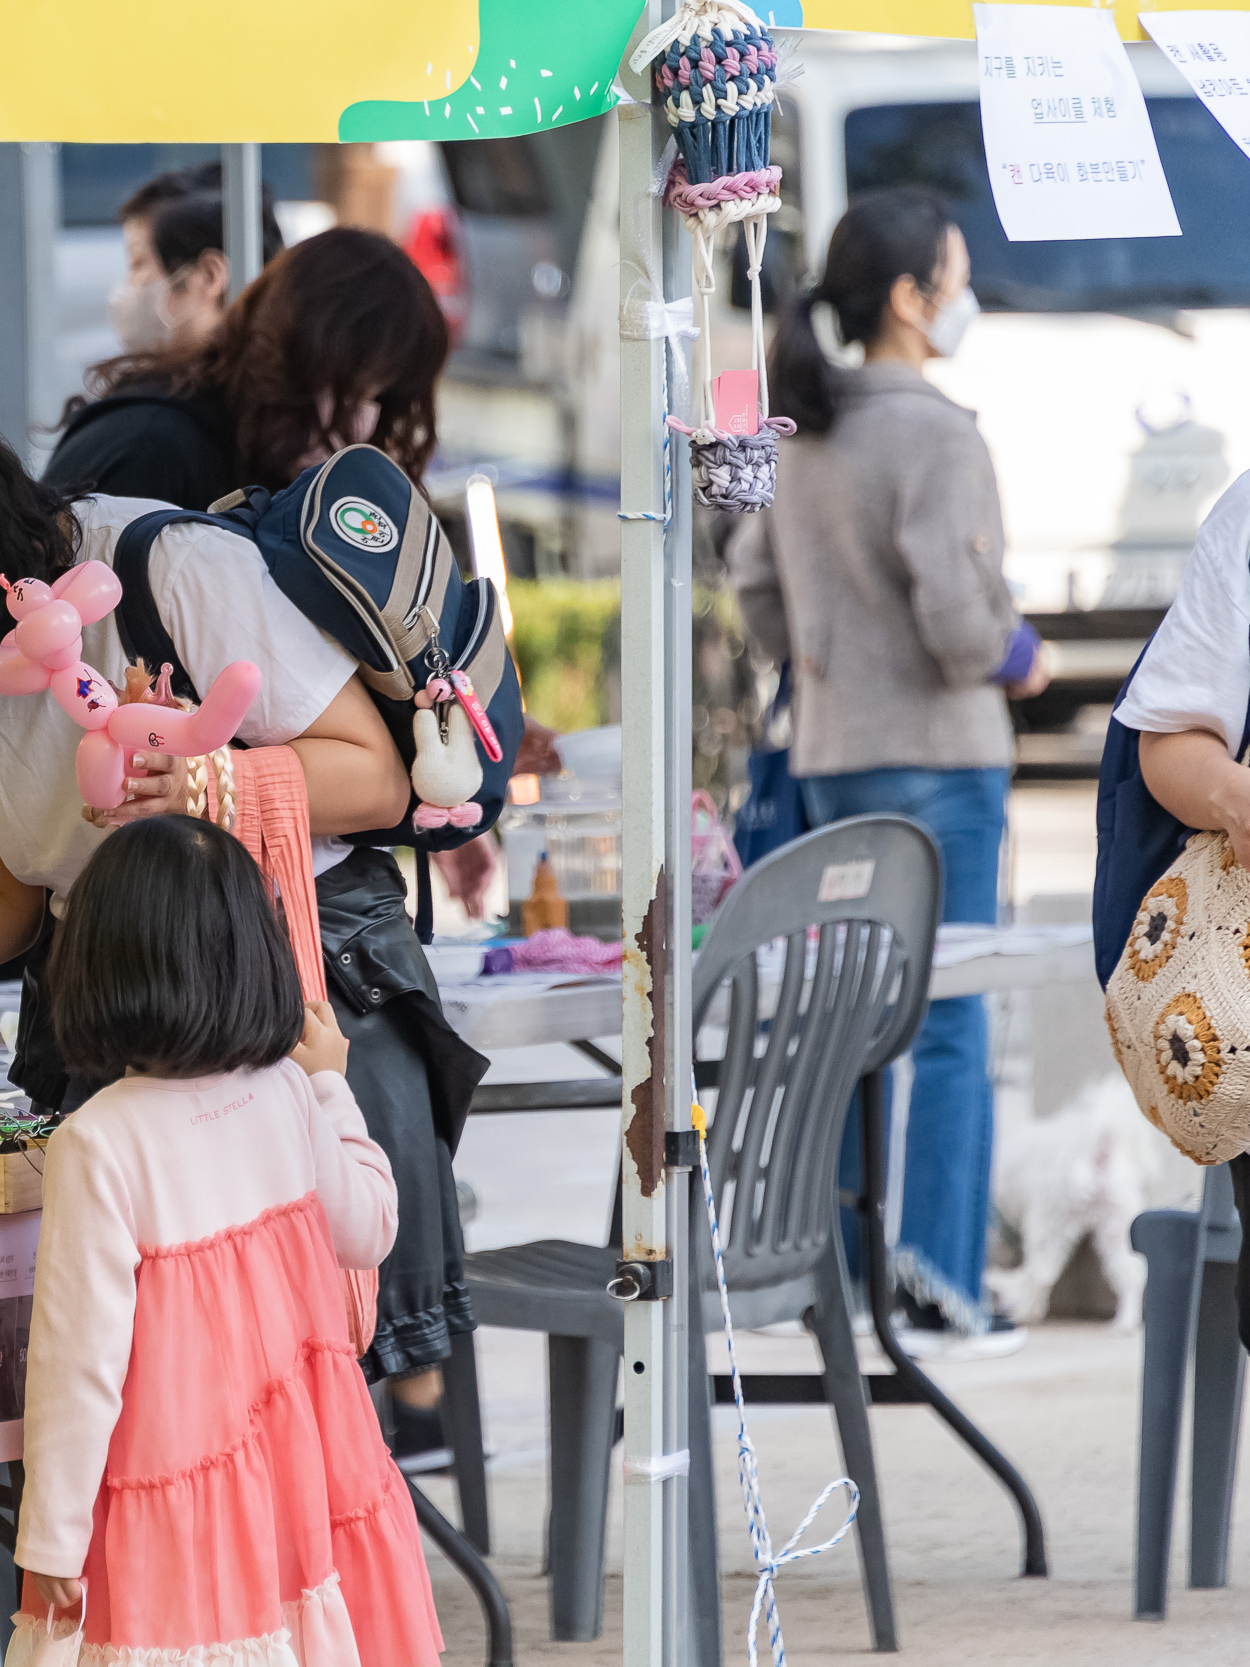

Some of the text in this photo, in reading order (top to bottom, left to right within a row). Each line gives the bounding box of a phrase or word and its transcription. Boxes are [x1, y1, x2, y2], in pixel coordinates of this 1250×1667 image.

[984, 56, 1064, 79] 지구를 지키는
[1031, 96, 1117, 120] 업사이클 체험
[1029, 162, 1070, 184] 다육이
[190, 1092, 254, 1125] LITTLE STELLA
